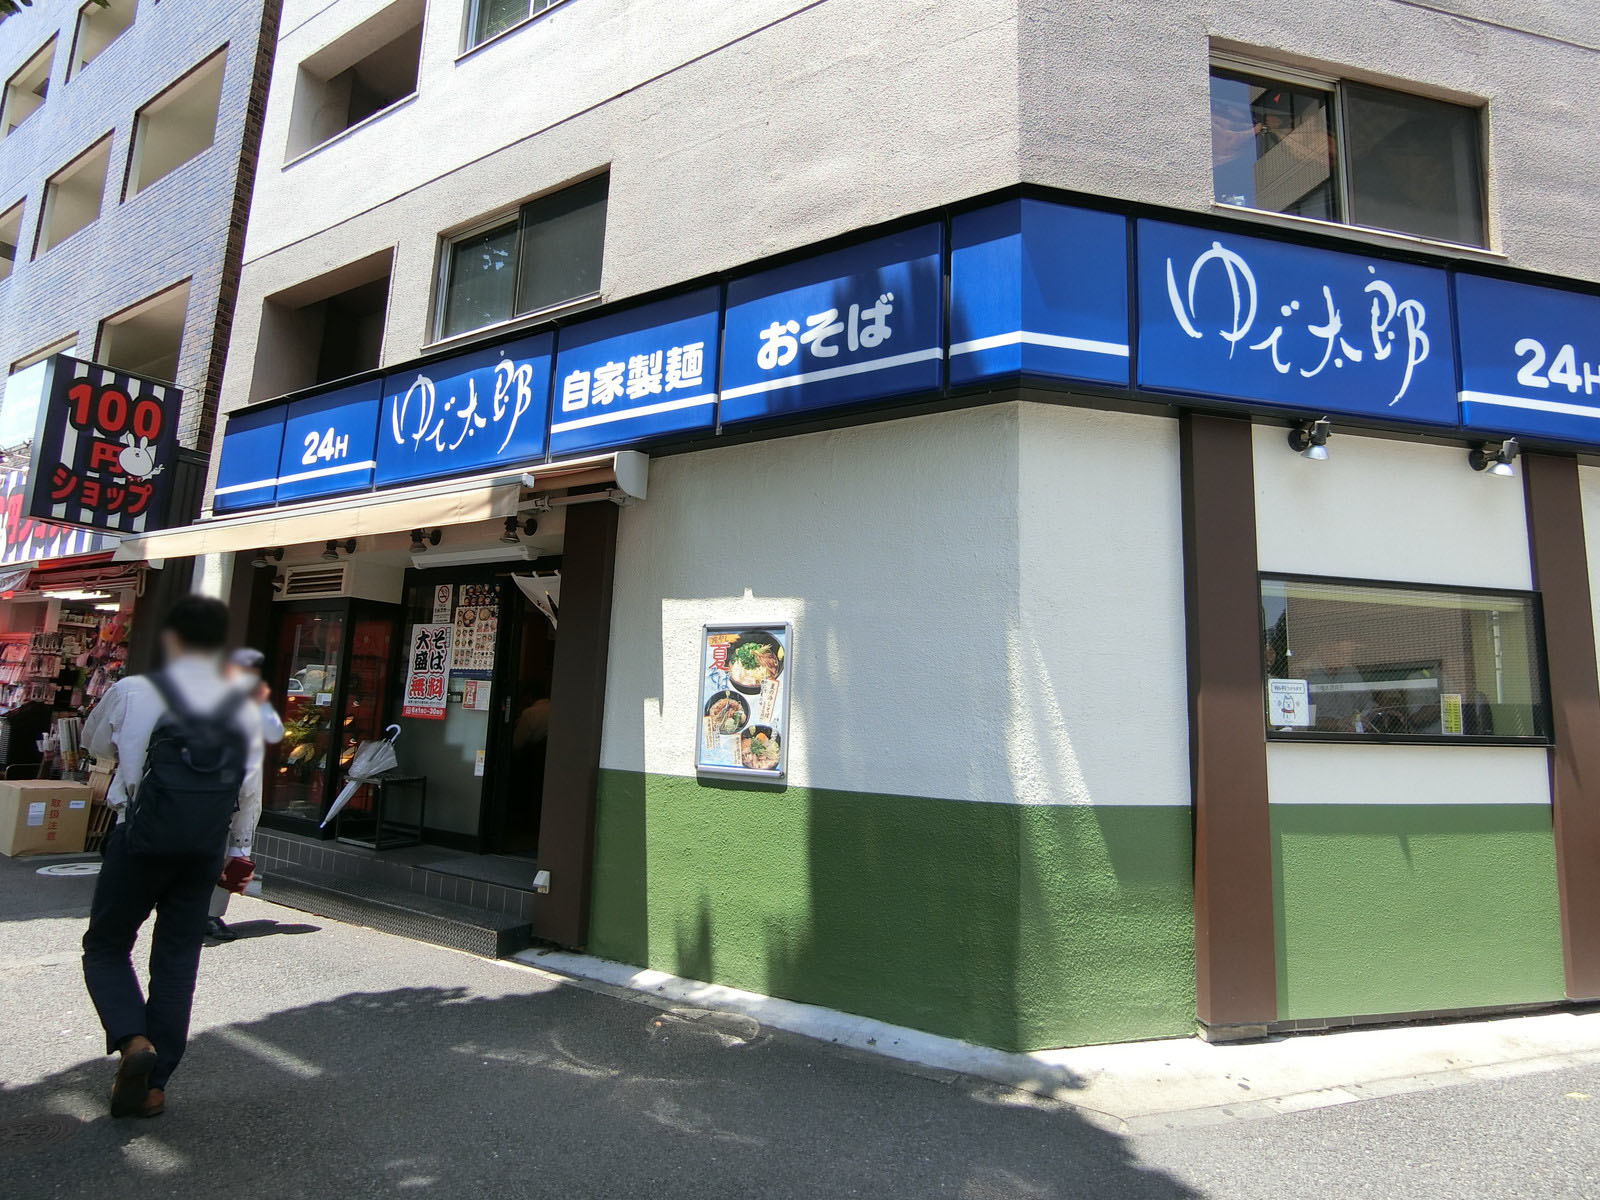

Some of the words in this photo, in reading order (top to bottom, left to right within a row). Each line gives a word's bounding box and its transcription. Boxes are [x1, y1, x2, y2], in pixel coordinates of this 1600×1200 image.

[756, 292, 894, 370] おそば
[1166, 241, 1430, 407] ゆで太郎
[562, 342, 704, 412] 自家製麺
[1514, 338, 1600, 395] 24H
[68, 384, 162, 440] 100
[392, 350, 532, 454] ゆで太郎
[90, 441, 126, 474] 円
[302, 427, 349, 465] 24H
[51, 468, 153, 513] ショップ
[414, 630, 430, 671] 大盛
[429, 629, 446, 671] そば
[709, 643, 730, 671] 夏
[409, 676, 443, 697] 無料
[709, 667, 729, 690] そば
